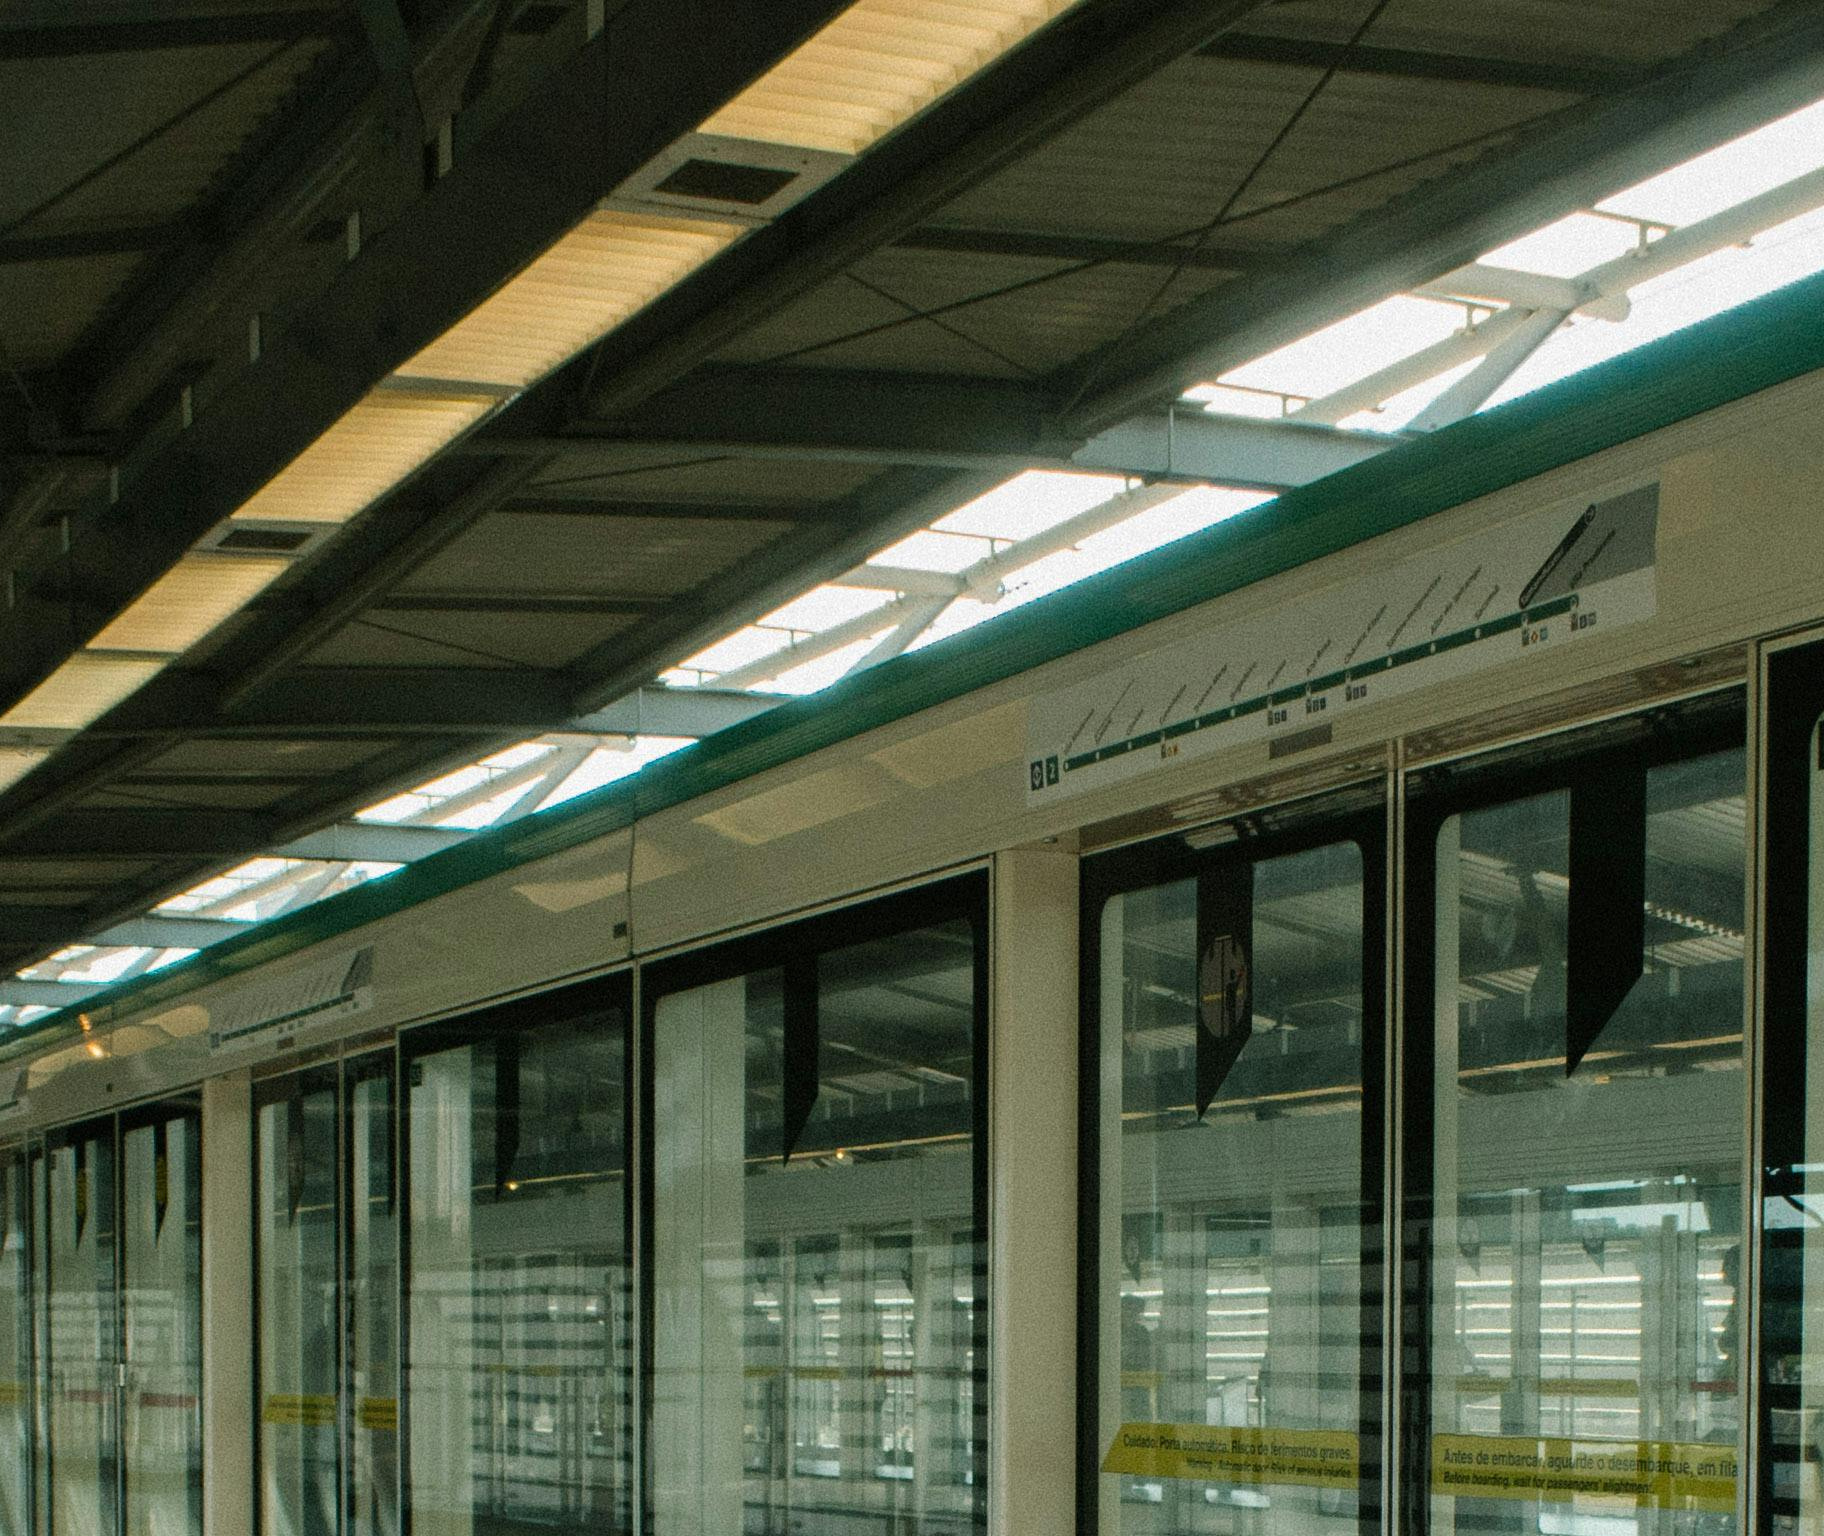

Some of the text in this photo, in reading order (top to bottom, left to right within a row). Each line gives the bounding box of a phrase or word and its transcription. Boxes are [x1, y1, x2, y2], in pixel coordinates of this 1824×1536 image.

[1443, 1448, 1473, 1464] Antes
[1476, 1450, 1489, 1465] de
[1548, 1453, 1594, 1471] aguarde
[1597, 1457, 1606, 1469] o
[1697, 1463, 1716, 1476] em
